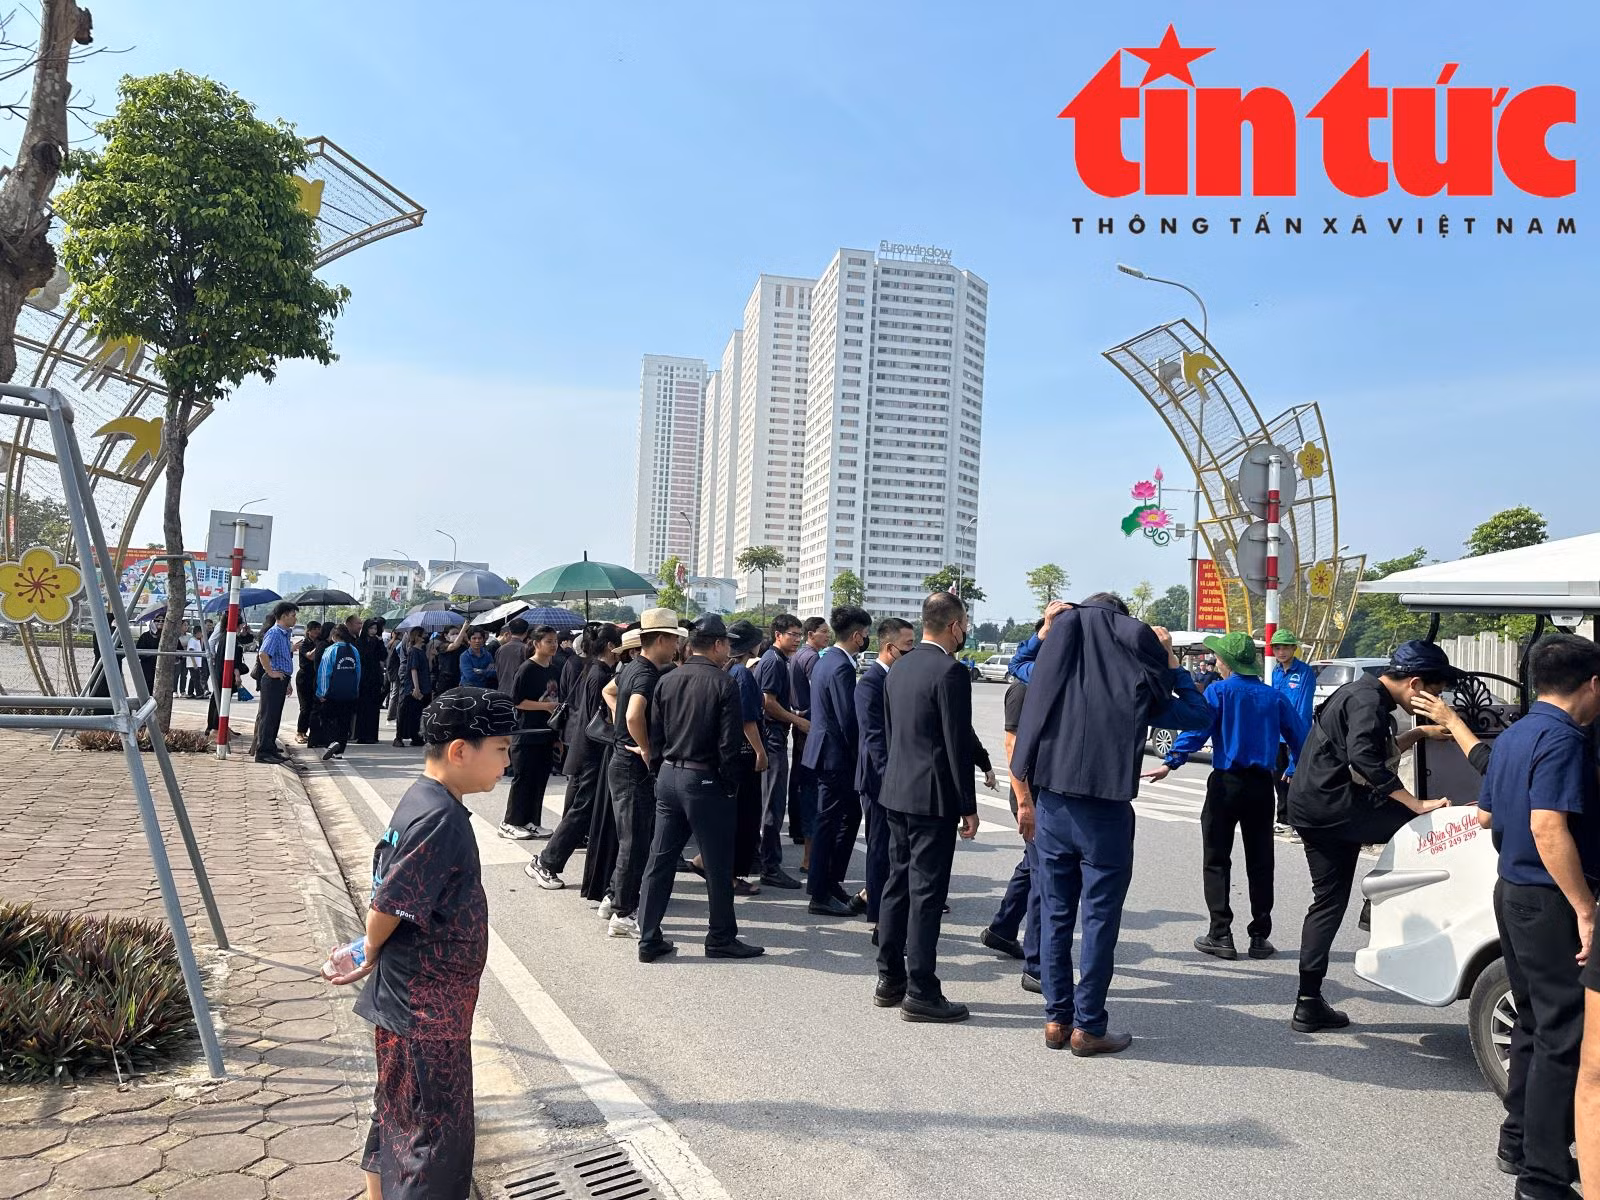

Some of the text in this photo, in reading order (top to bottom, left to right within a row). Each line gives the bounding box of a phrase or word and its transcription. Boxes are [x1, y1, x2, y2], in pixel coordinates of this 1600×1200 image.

[1430, 830, 1477, 855] 0987 249 299
[395, 909, 415, 920] sport
